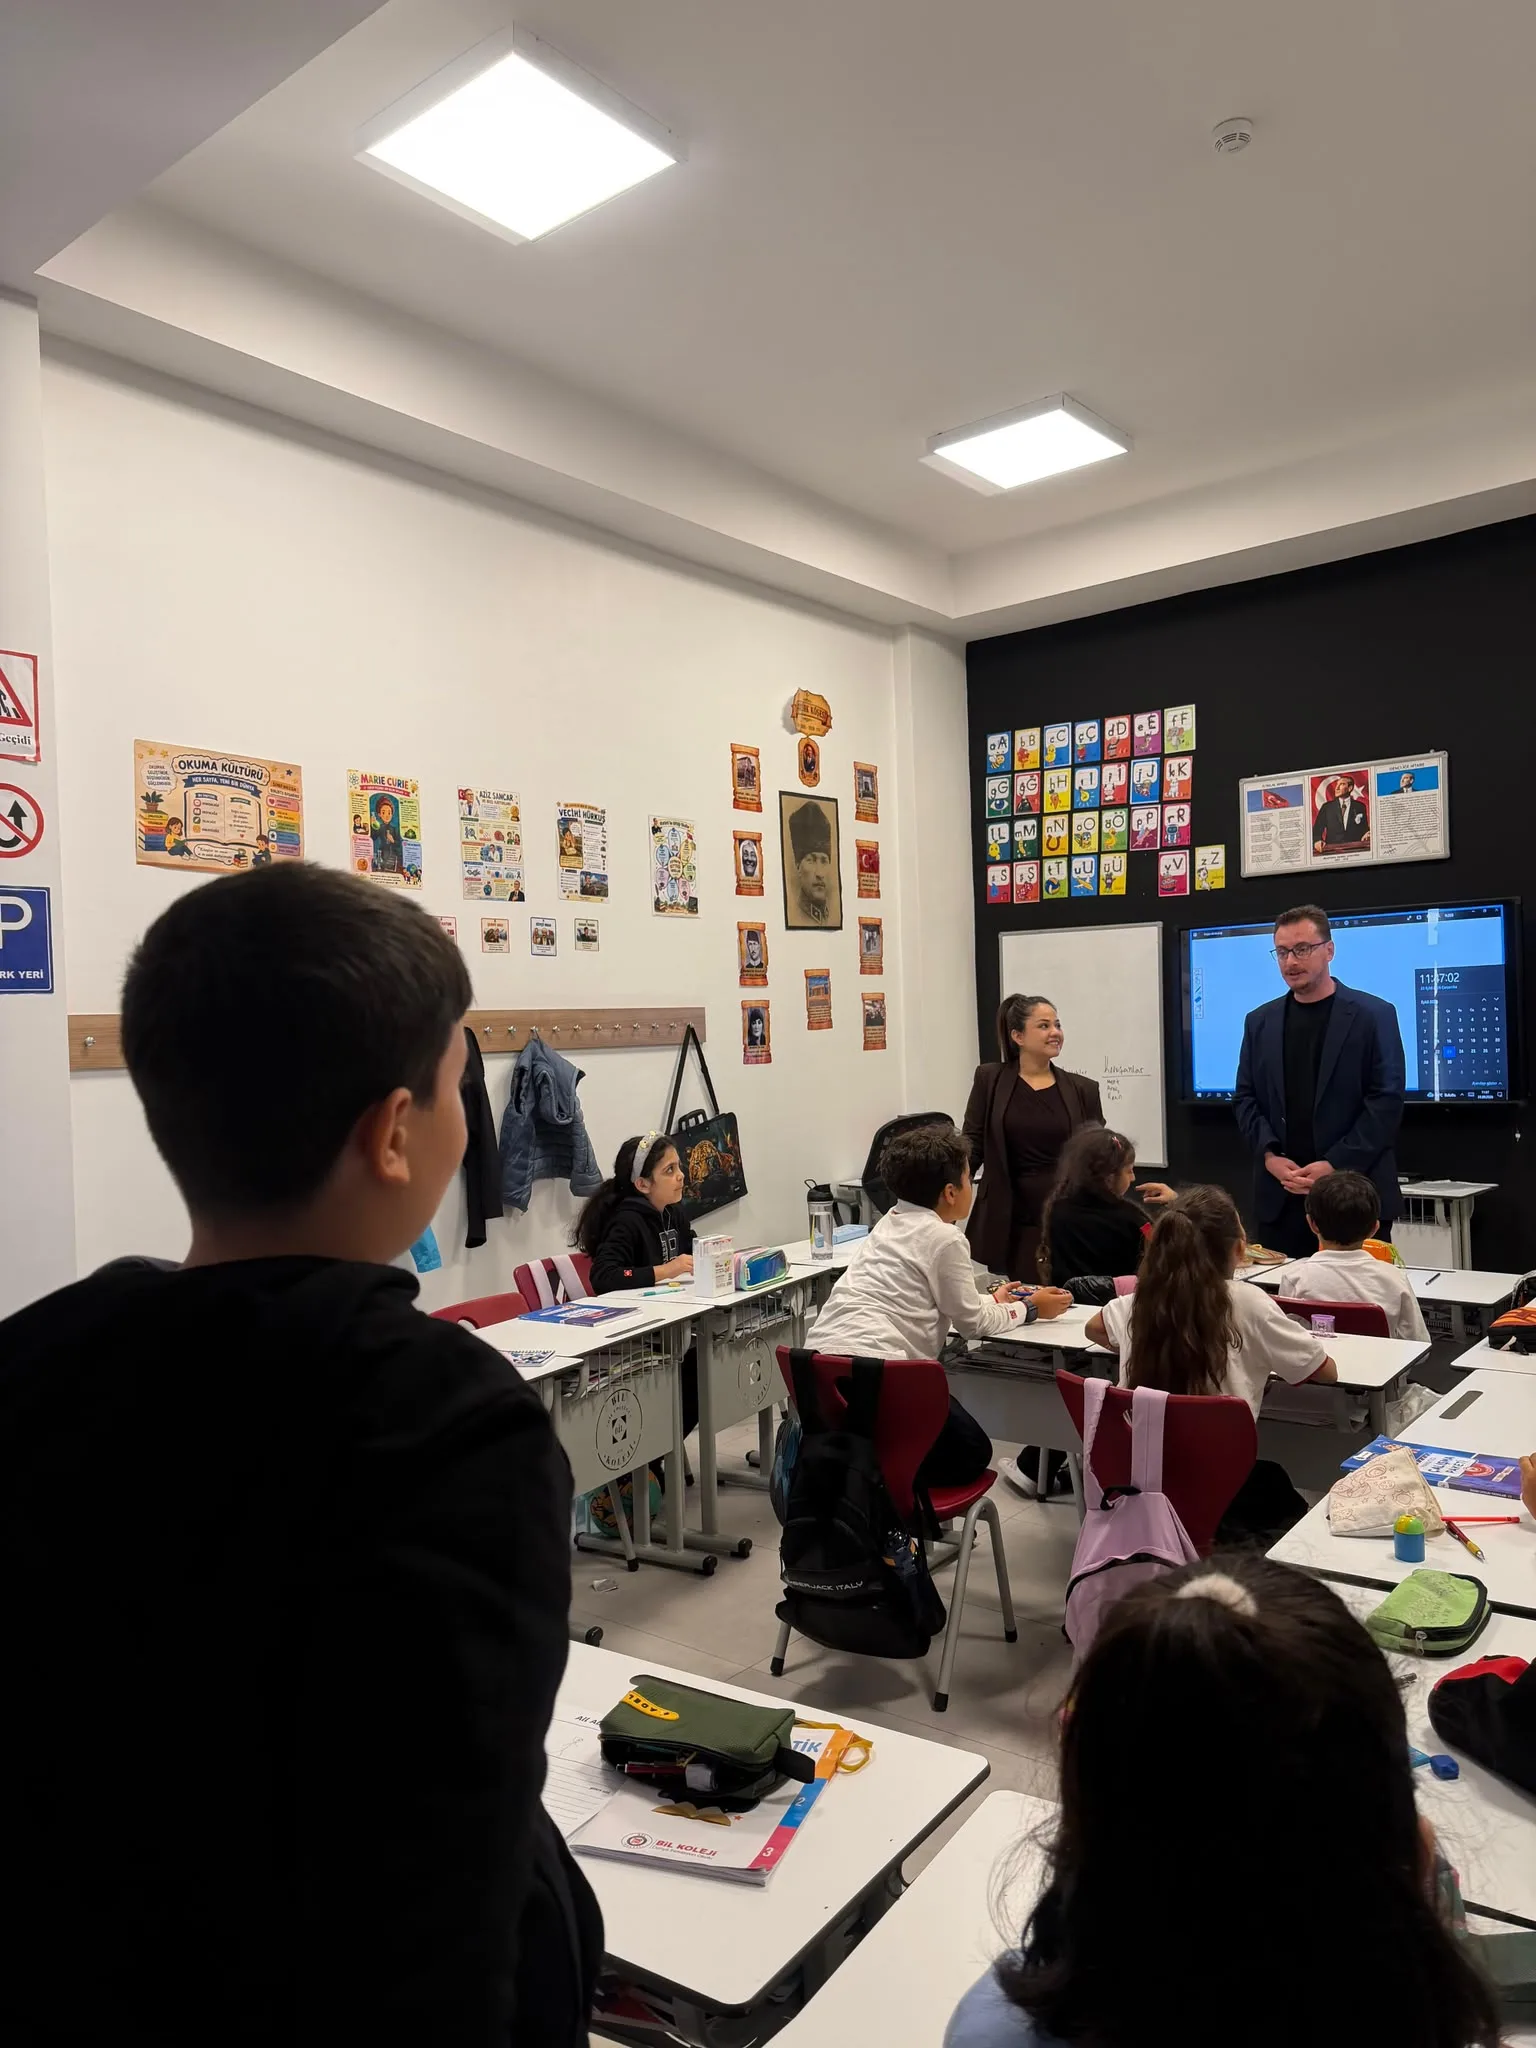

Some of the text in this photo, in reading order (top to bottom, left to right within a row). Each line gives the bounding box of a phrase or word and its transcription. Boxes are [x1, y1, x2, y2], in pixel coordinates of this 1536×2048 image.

[178, 760, 264, 780] OKUMA KÜLTÜRÜ
[360, 774, 408, 790] MARIE CURIE
[480, 790, 514, 801] AZİZ SANCAR
[558, 808, 581, 818] VECİHİ
[582, 810, 606, 824] HÜRKUŞ
[0, 896, 32, 950] P
[18, 968, 44, 978] YERİ
[836, 1580, 864, 1590] ITALY
[825, 1748, 832, 1758] 1
[795, 1797, 806, 1807] 2
[762, 1847, 774, 1858] 3
